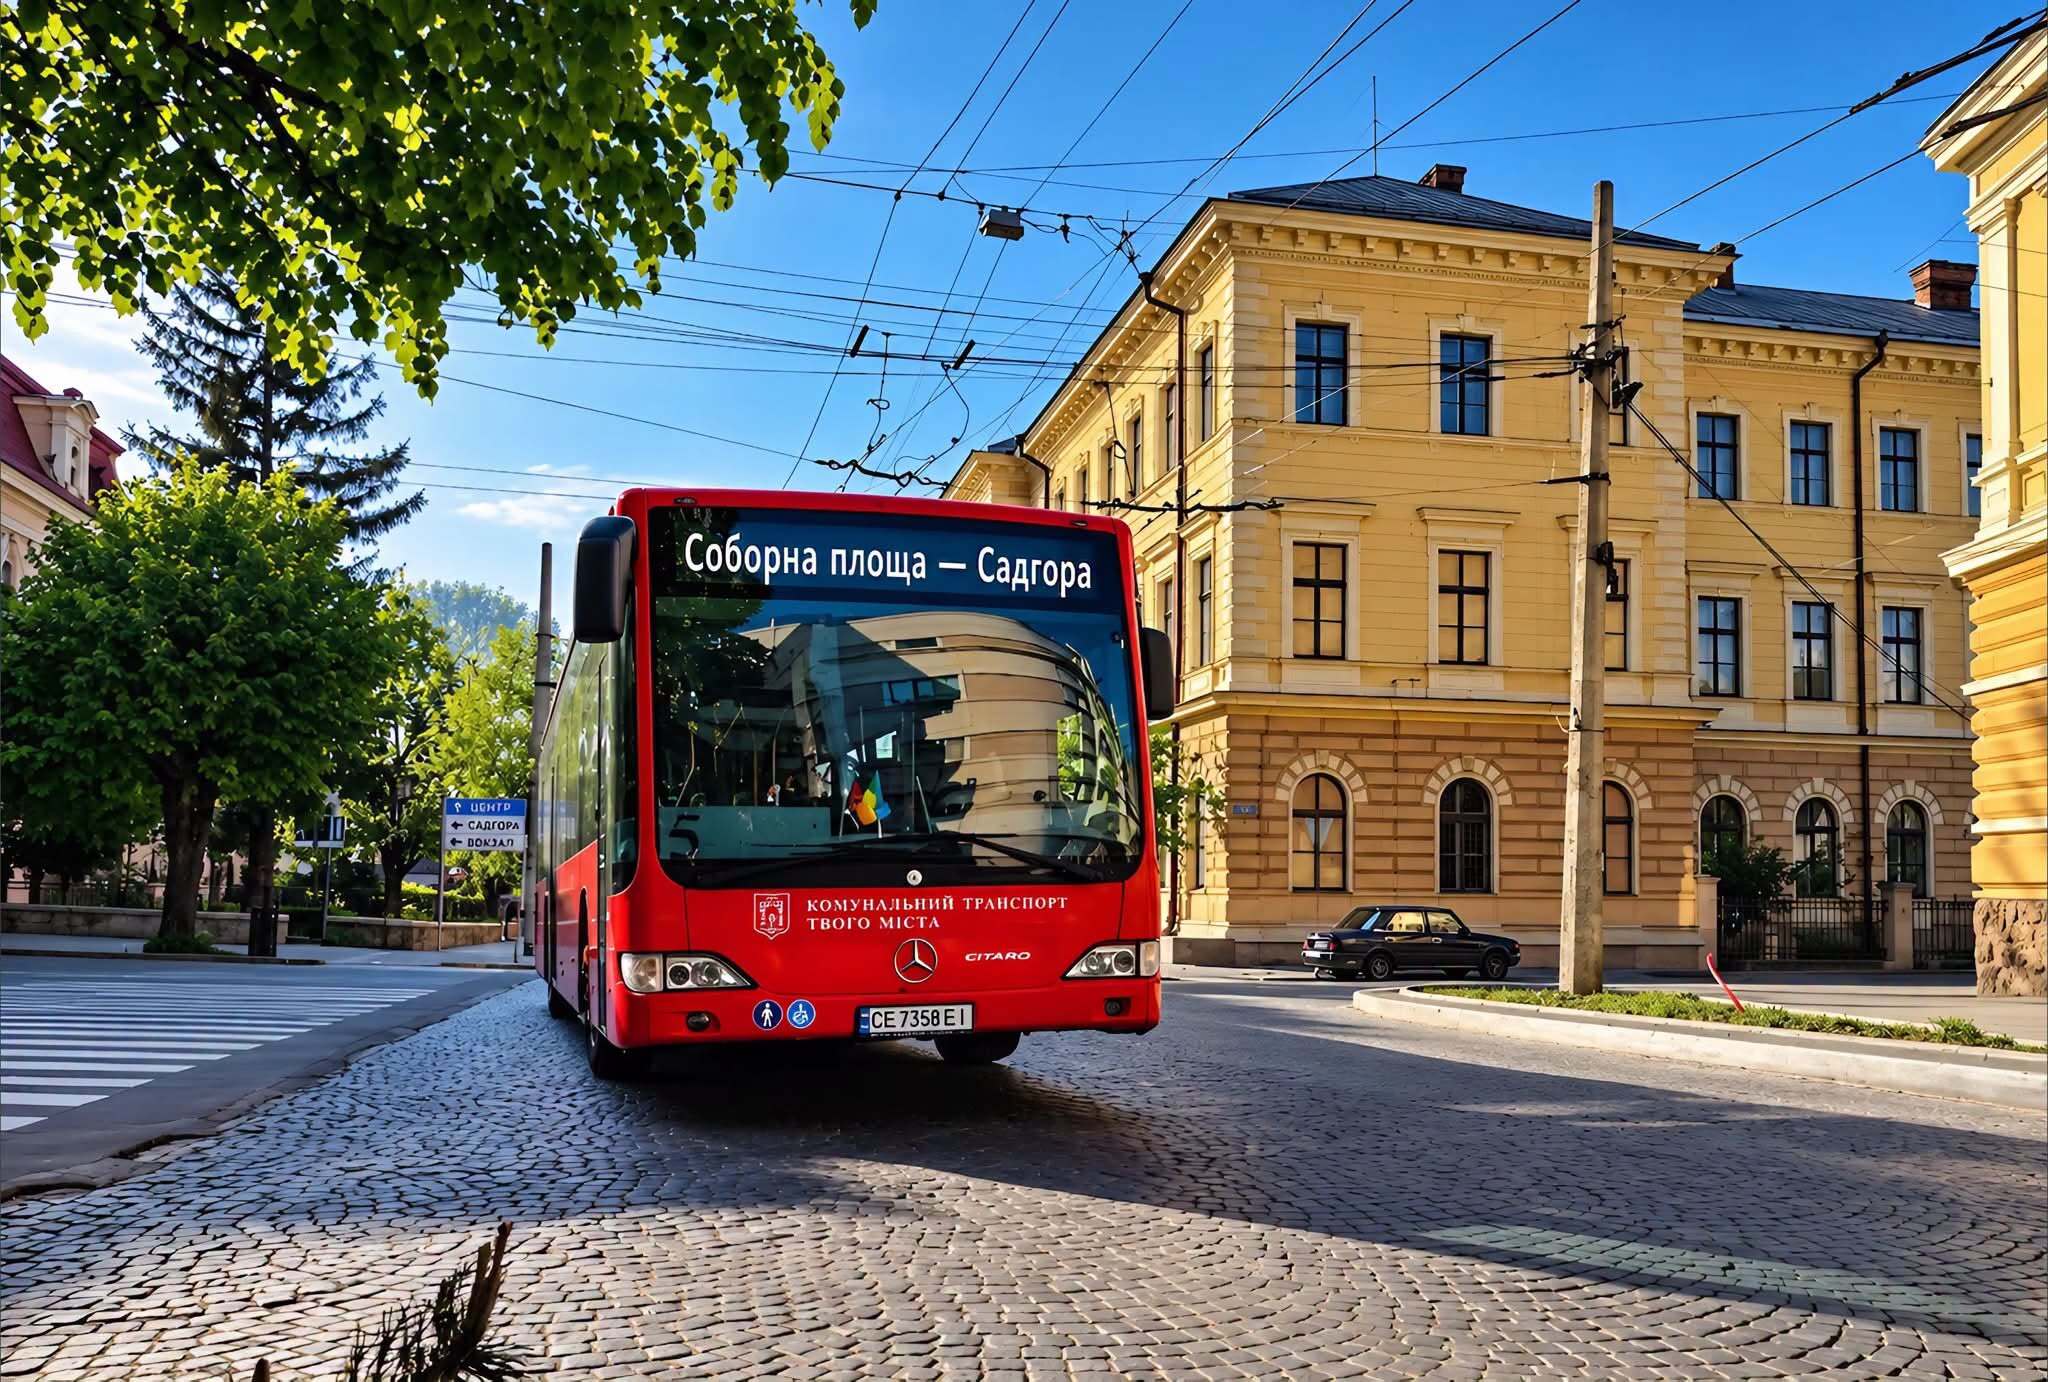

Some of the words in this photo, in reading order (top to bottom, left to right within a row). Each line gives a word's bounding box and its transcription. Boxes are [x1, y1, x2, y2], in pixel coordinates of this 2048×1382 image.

[684, 532, 817, 586] Соборна
[831, 548, 927, 587] площа
[977, 546, 1092, 599] Садгора
[470, 802, 512, 813] ЦЕНТР
[468, 820, 520, 831] САДГОРА
[807, 895, 955, 912] КОМУНАЛЬНИЙ
[962, 896, 1068, 910] ТРАНСПОРТ
[806, 917, 871, 930] ТВОГО
[880, 915, 940, 929] МІСТА
[965, 951, 1032, 962] CITARO
